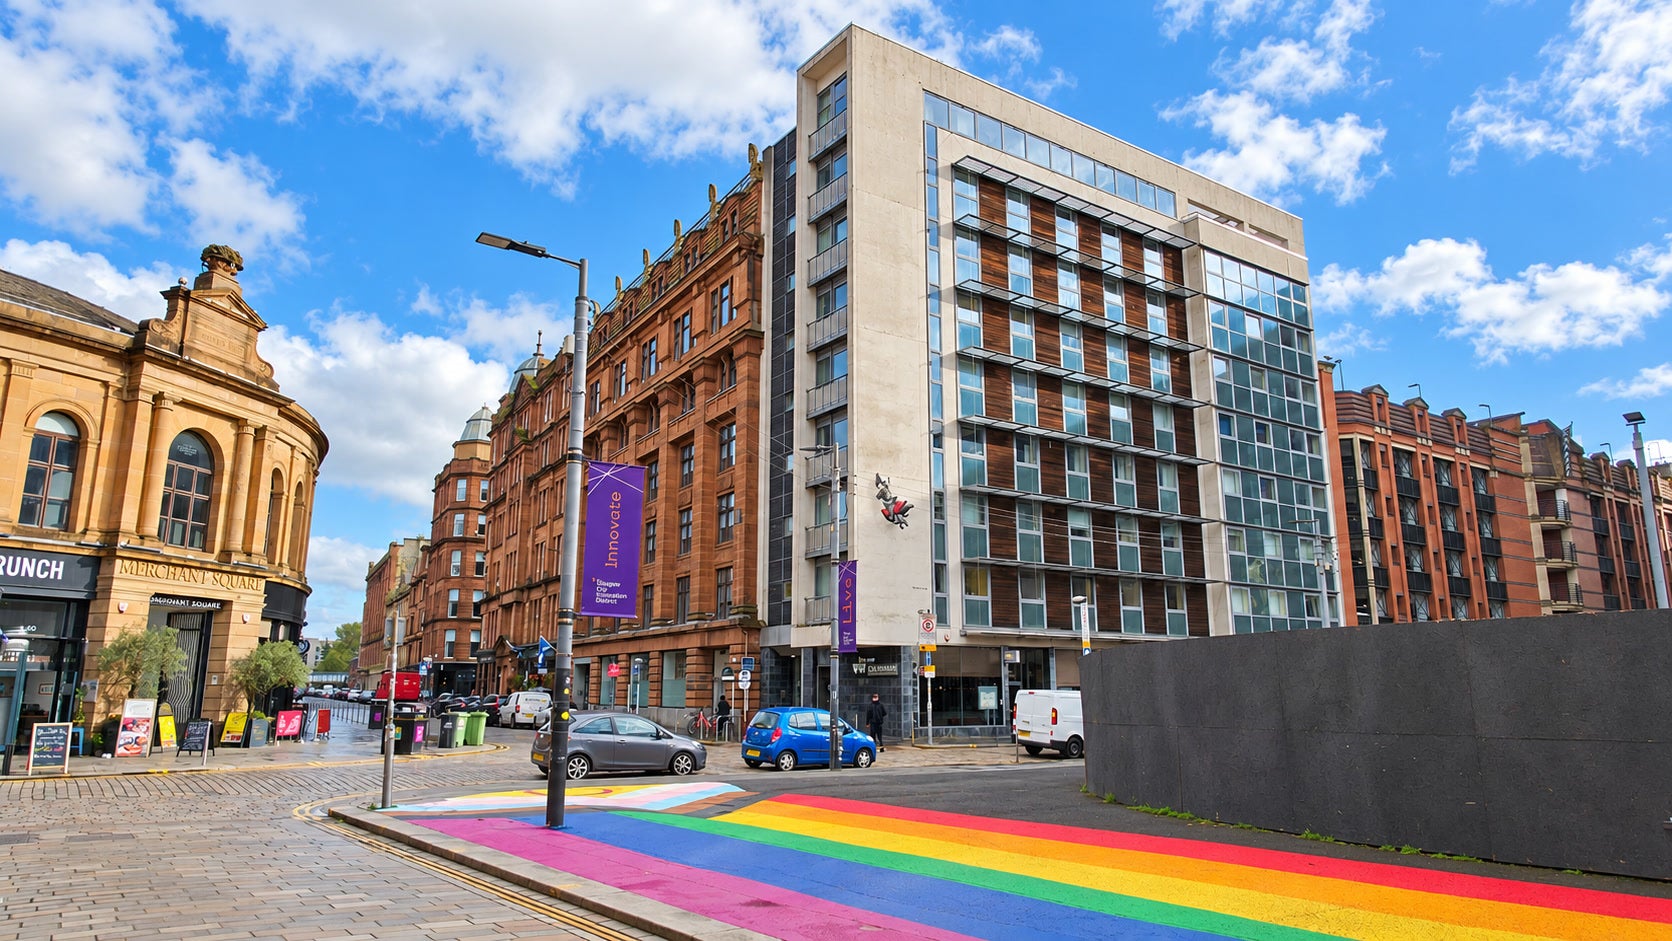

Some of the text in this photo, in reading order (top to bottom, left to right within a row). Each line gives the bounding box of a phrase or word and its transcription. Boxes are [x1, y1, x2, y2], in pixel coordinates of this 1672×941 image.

[605, 491, 622, 568] Innovate
[120, 560, 262, 591] MERCHANT SQUARE
